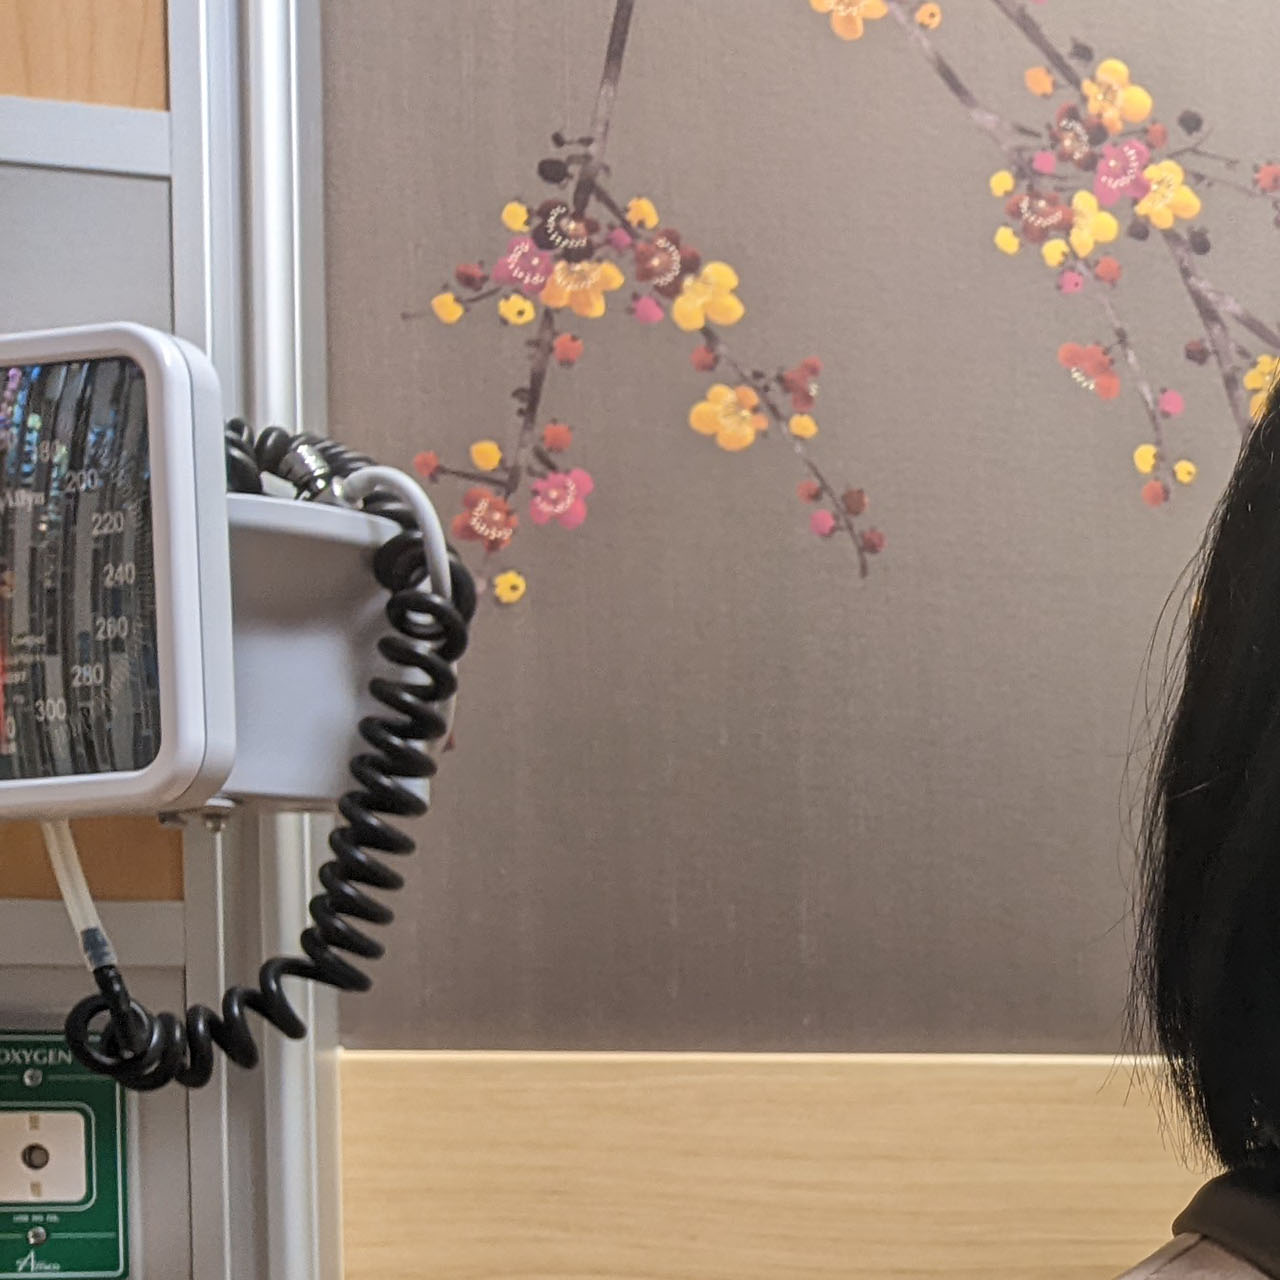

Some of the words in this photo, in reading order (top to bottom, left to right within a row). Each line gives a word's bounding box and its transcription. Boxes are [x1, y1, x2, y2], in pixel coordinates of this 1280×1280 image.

[66, 469, 99, 491] 200
[92, 511, 124, 536] 220
[103, 562, 136, 588] 240
[96, 616, 128, 641] 260
[71, 664, 105, 687] 280
[35, 699, 67, 722] 300
[0, 1049, 72, 1066] OXYGEN
